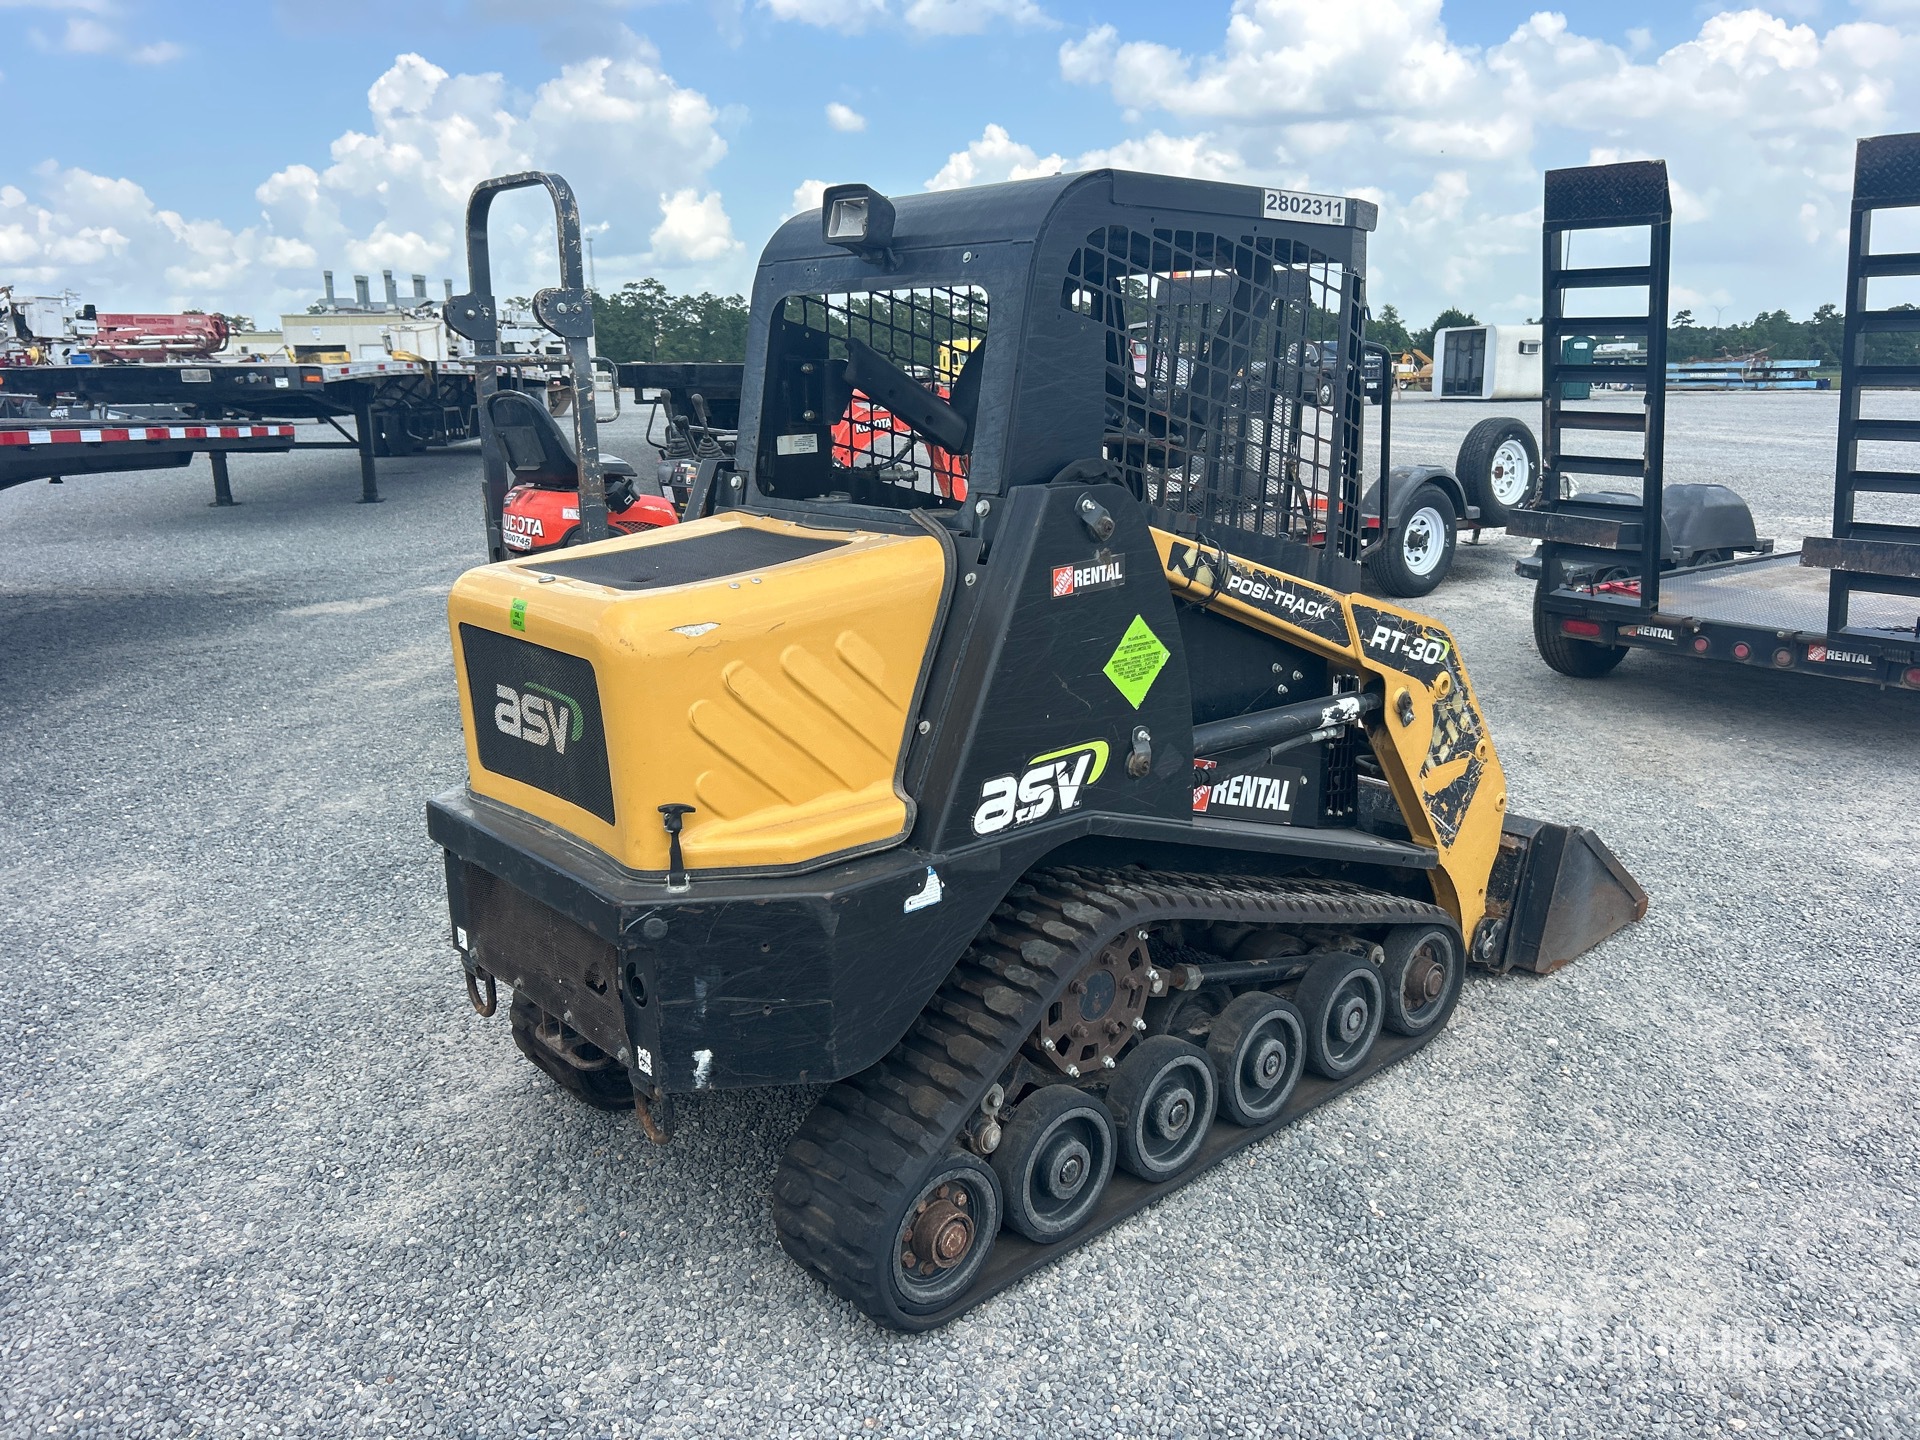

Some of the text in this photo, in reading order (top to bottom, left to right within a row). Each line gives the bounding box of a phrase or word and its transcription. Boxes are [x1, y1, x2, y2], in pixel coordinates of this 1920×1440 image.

[1265, 194, 1342, 217] 2802311
[1074, 562, 1123, 588] RENTAL
[1226, 575, 1329, 620] POSI-TRACK
[1369, 625, 1441, 665] RT-30
[1636, 626, 1675, 640] RENTAL
[1826, 649, 1872, 665] RENTAL
[495, 683, 569, 755] asv
[974, 753, 1091, 835] asv
[1210, 774, 1291, 812] RENTAL
